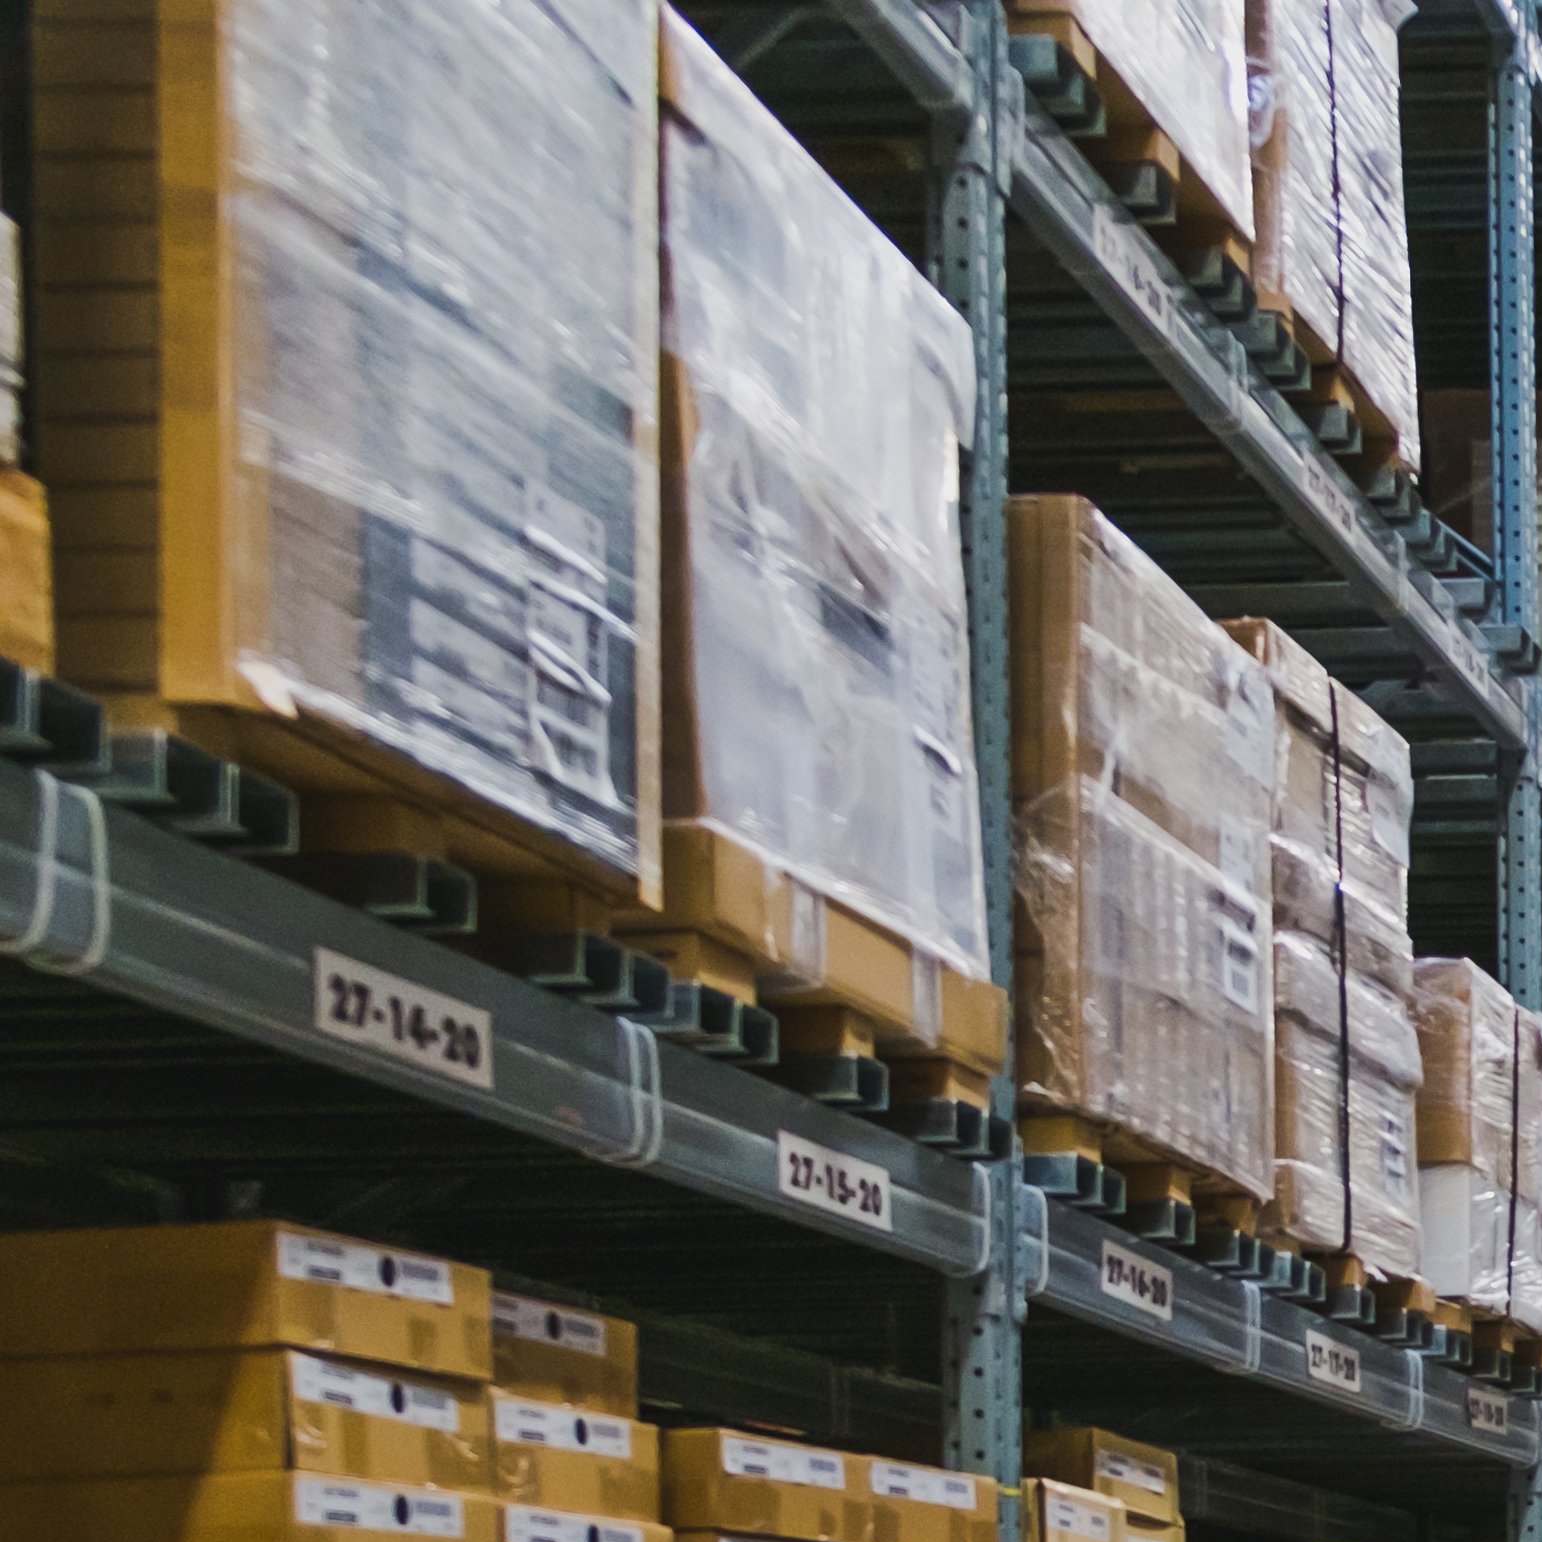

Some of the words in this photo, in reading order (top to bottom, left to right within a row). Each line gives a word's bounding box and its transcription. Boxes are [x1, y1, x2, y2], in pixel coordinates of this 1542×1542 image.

[328, 972, 480, 1069] 27-14-20
[789, 1152, 882, 1216] 27-15-20
[1107, 1254, 1168, 1308] 27-16-20
